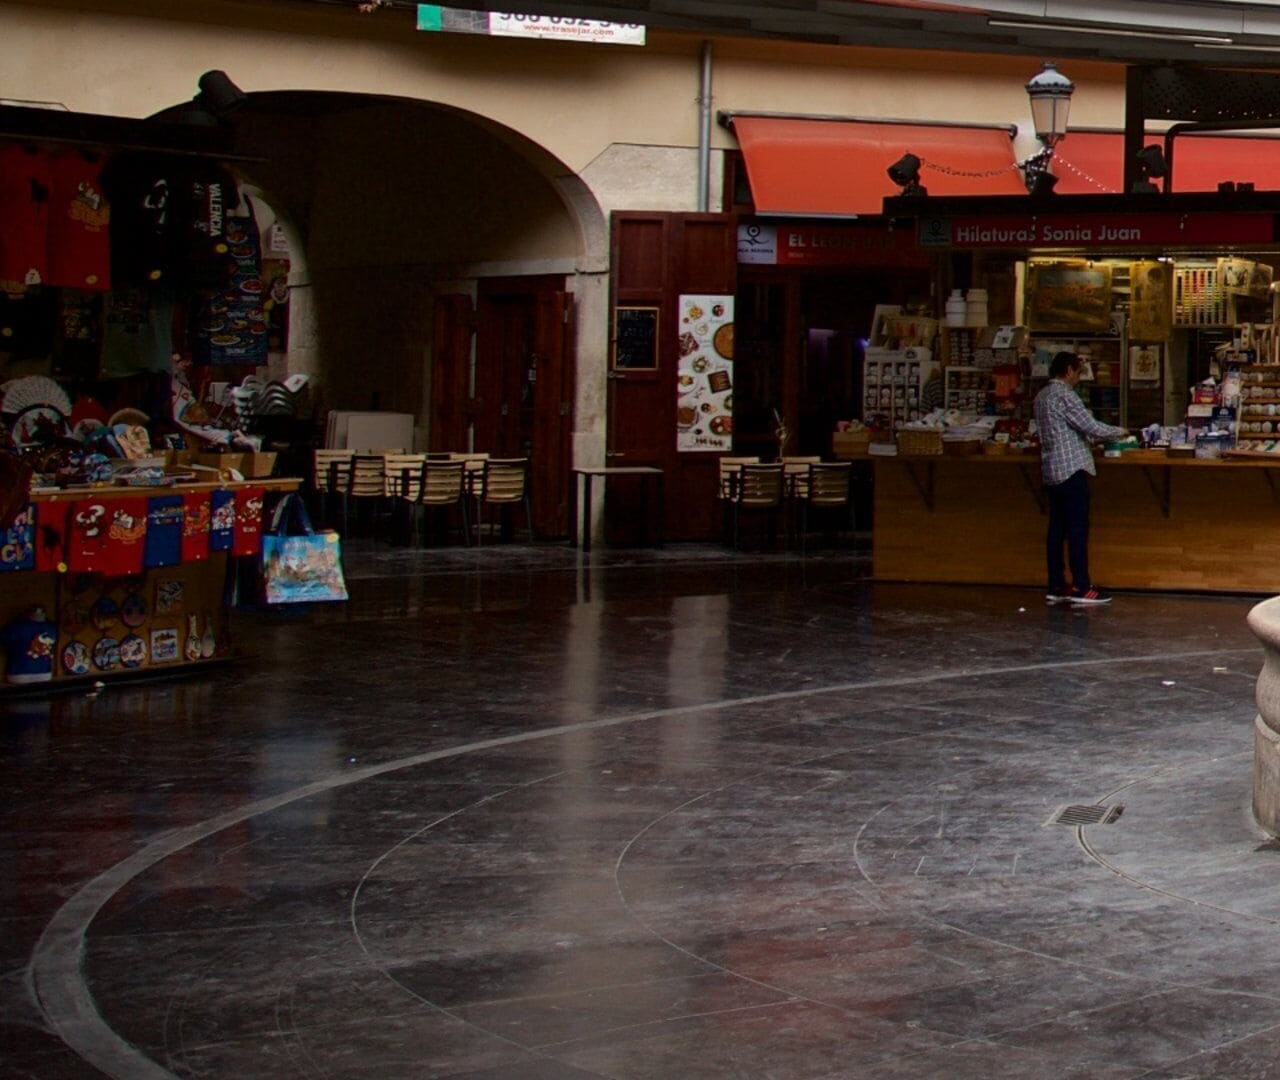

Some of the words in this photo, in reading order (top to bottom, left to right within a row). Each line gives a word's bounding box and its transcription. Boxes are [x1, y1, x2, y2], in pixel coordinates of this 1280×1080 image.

[208, 183, 223, 237] VALENCIA
[788, 233, 807, 248] EL
[957, 225, 1036, 243] Hilaturas
[1042, 224, 1092, 241] Sonia
[1097, 225, 1141, 241] Juan
